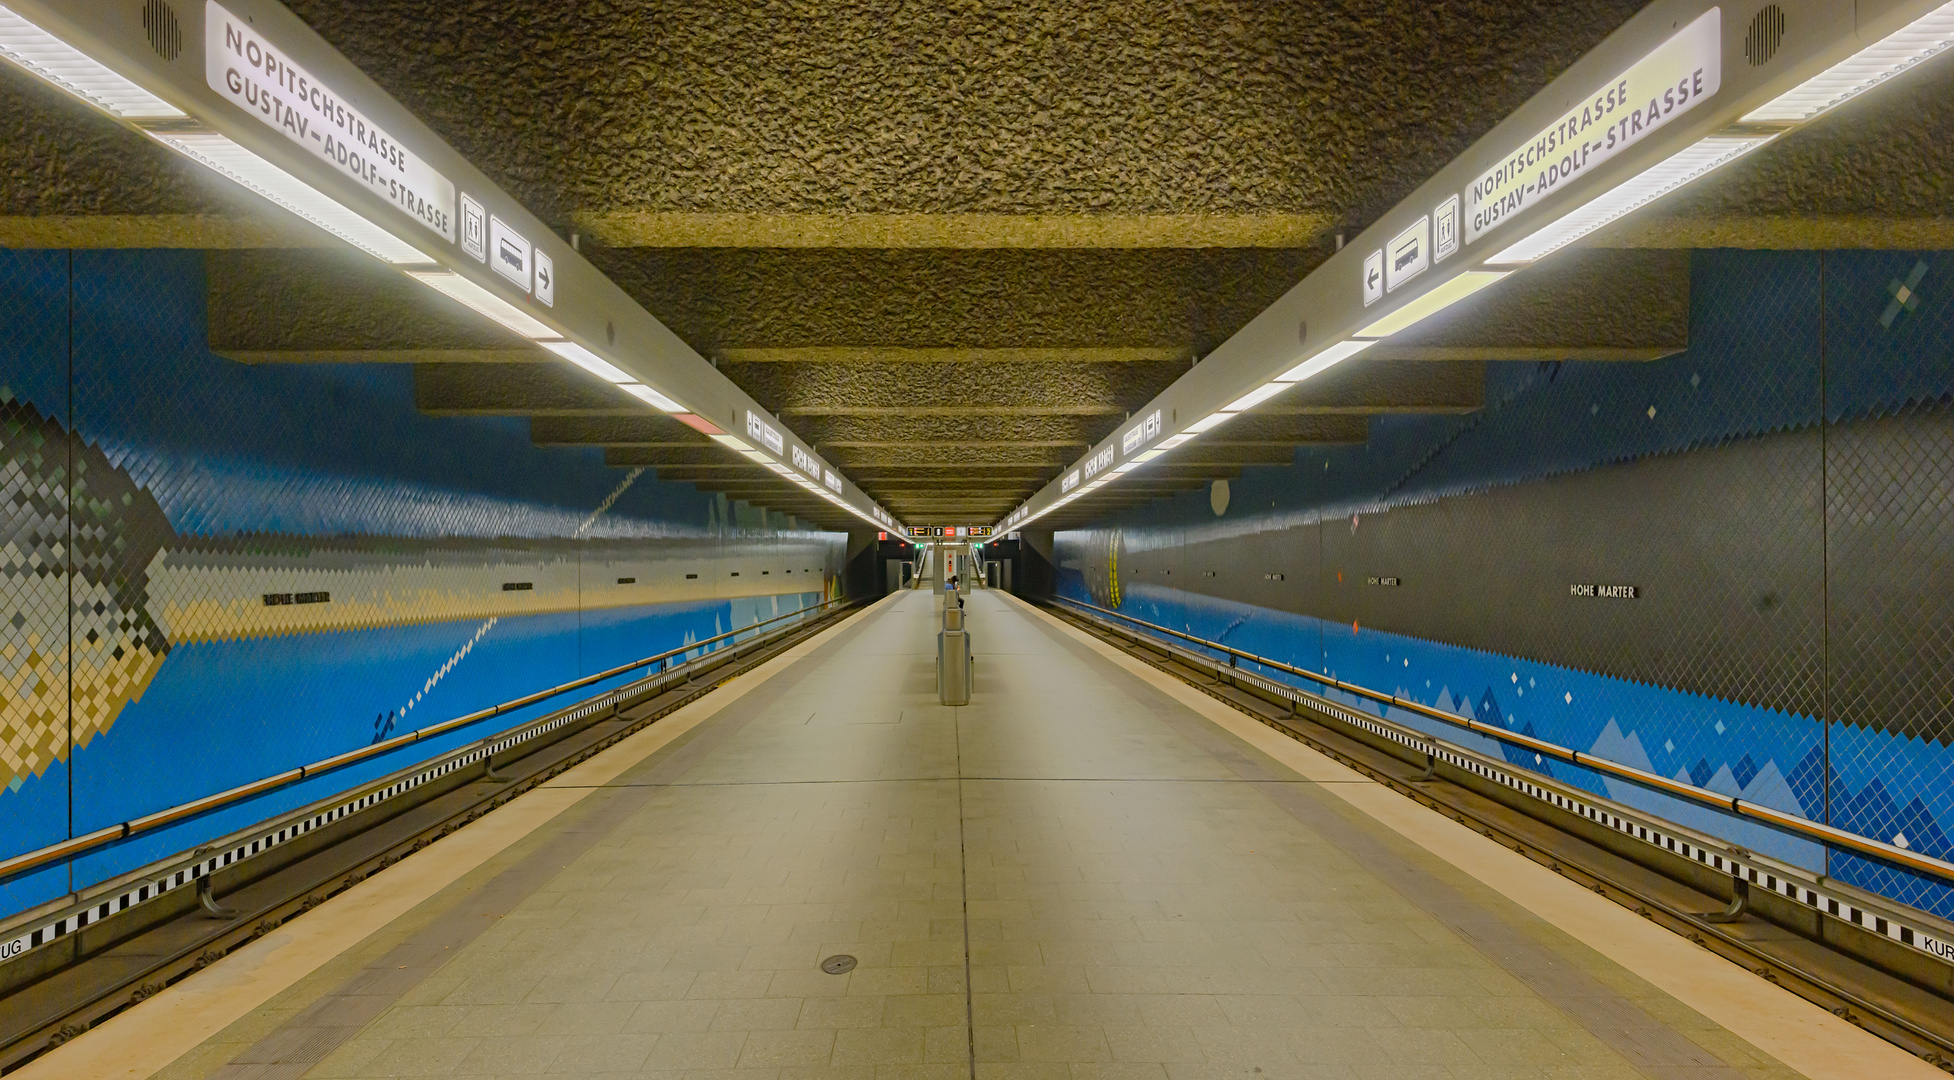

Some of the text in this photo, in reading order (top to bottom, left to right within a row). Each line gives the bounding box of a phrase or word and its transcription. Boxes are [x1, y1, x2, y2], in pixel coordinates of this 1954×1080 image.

[226, 21, 405, 173] NOPITSCHSTRASSE
[226, 67, 448, 234] GUSTAV-ADOLF-STRASSE
[1474, 79, 1627, 204] NOPITSCHSTRASSE
[1474, 67, 1703, 232] GUSTAV-ADOLF-STRASSE
[1570, 584, 1635, 598] HOHE MARTER
[1924, 936, 1954, 960] KUR
